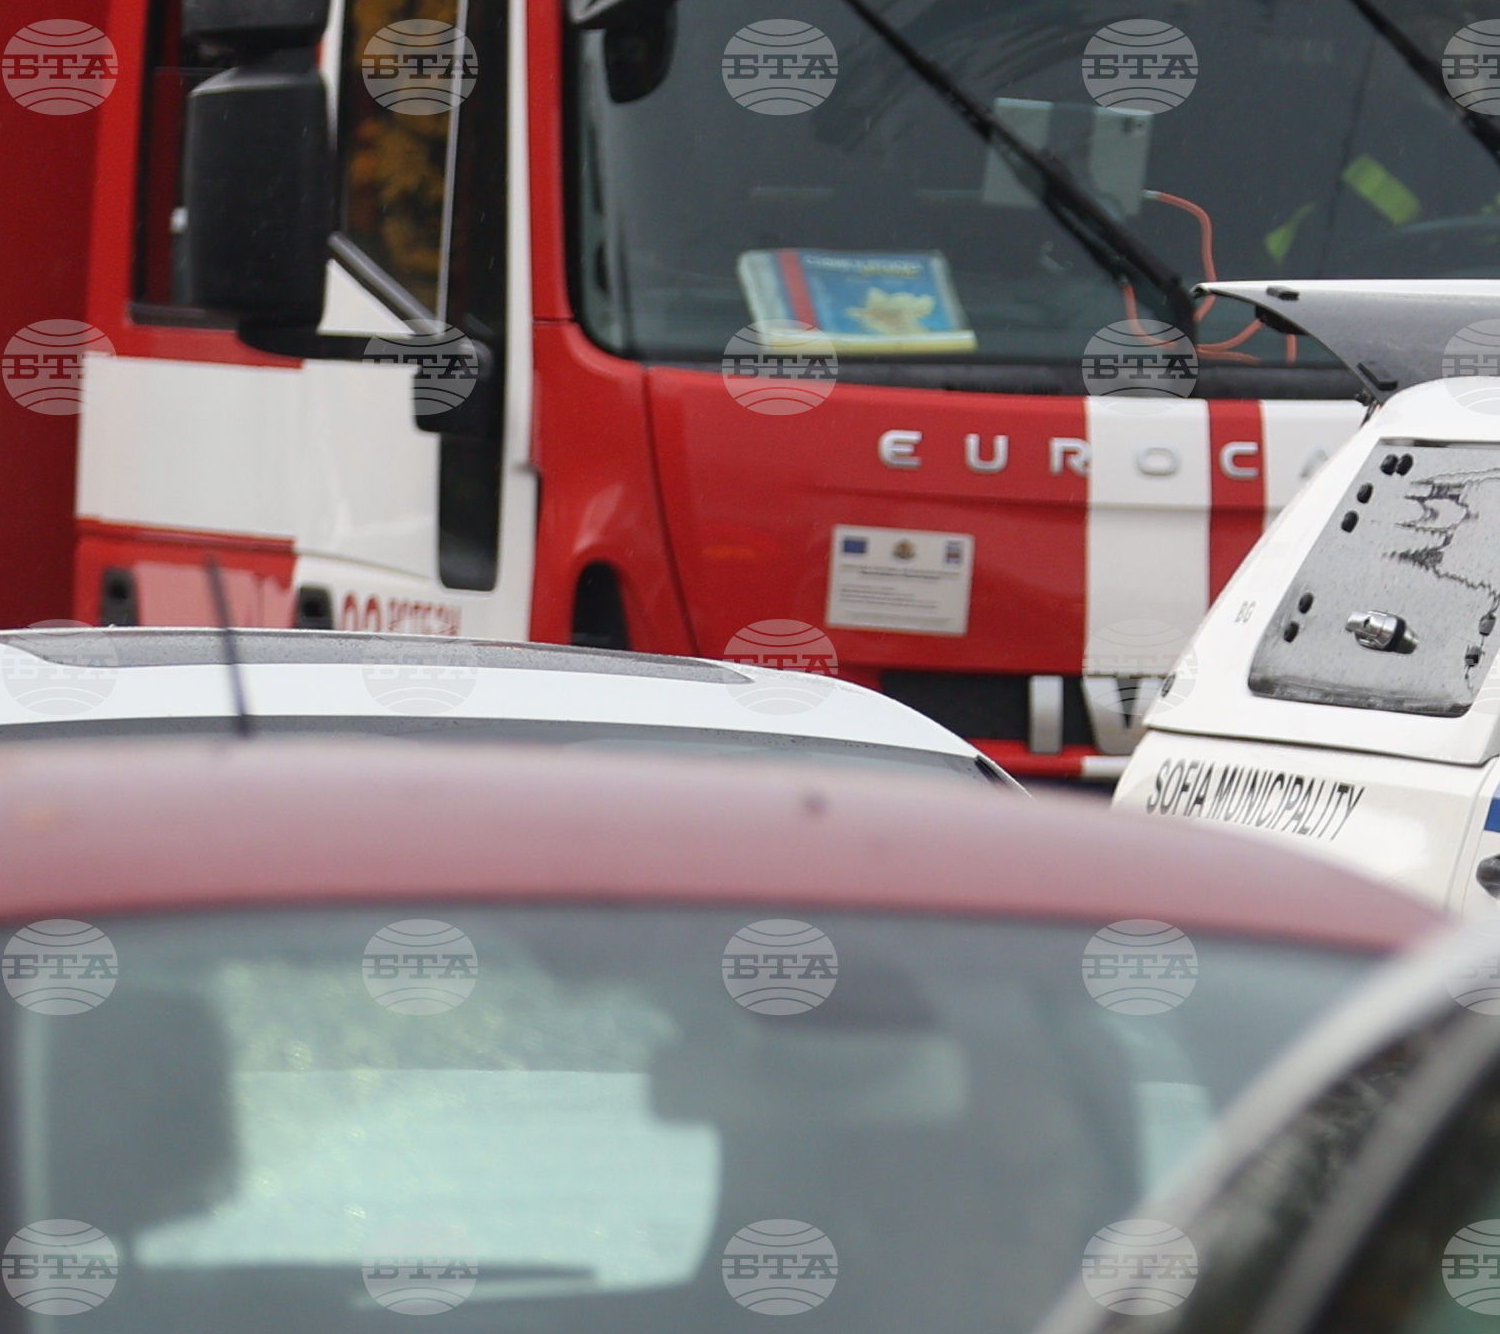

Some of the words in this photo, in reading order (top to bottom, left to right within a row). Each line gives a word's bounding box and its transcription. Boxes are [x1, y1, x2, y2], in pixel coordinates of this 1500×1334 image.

[1234, 600, 1257, 623] BG
[1146, 758, 1215, 817] SOFIA
[1207, 764, 1366, 841] MUNICIPALITY
